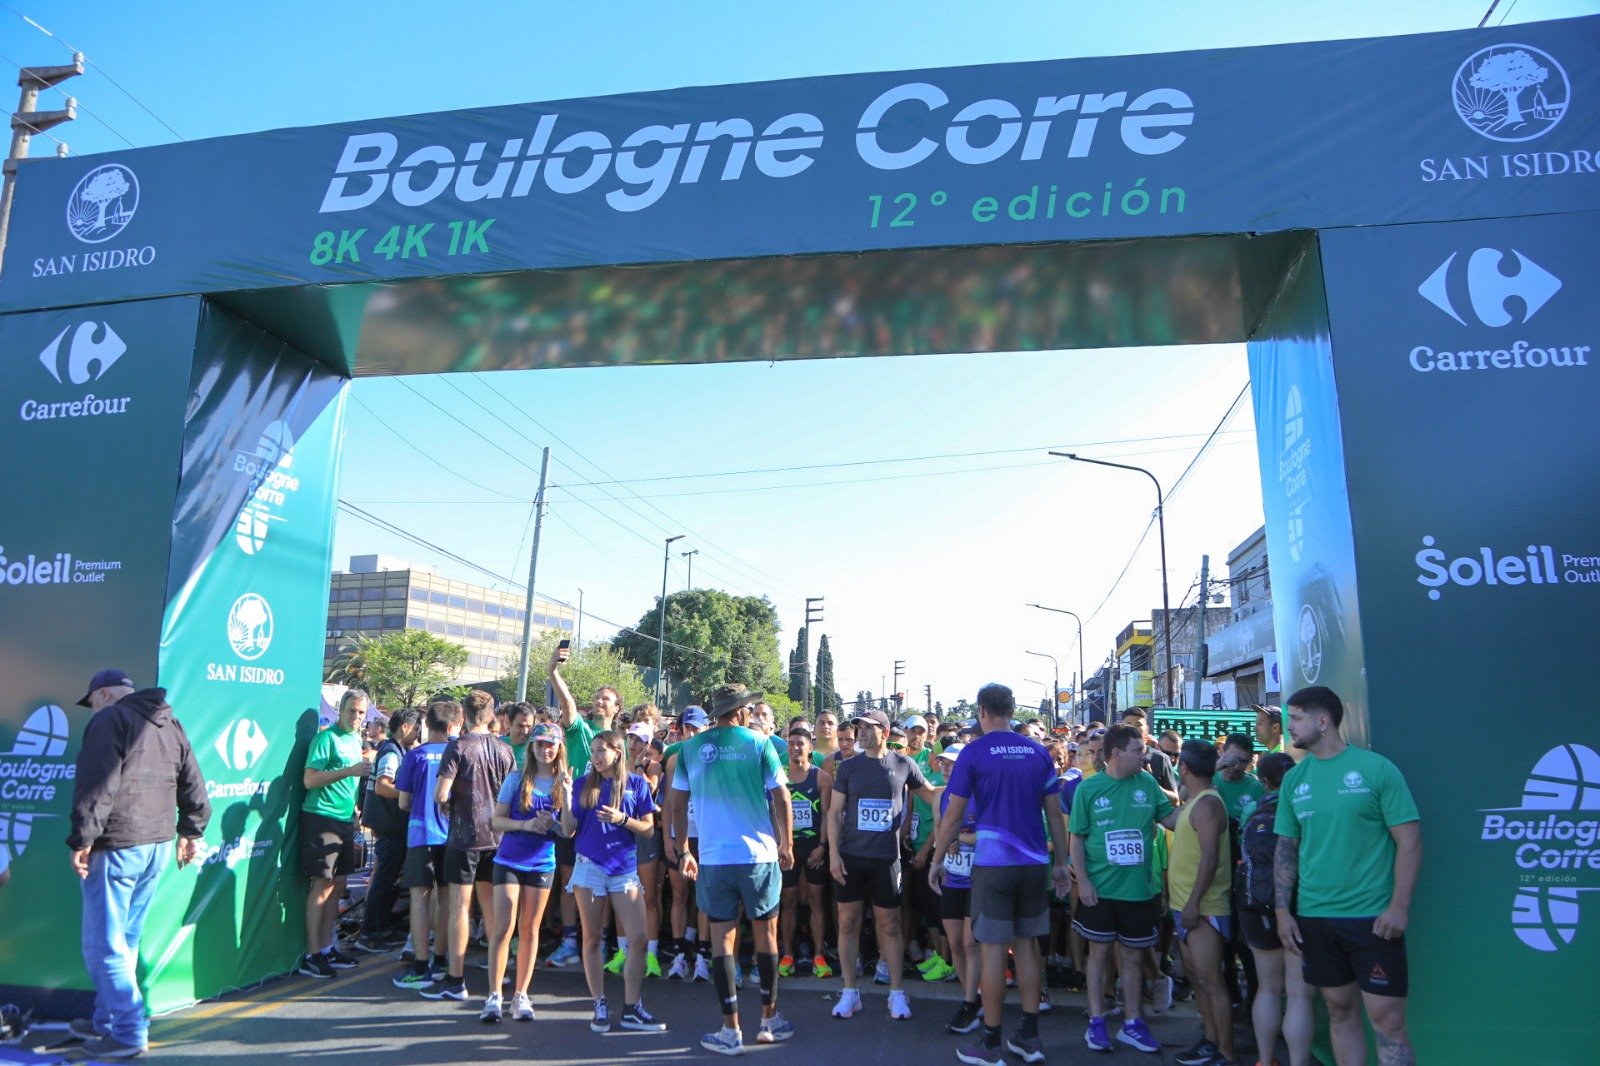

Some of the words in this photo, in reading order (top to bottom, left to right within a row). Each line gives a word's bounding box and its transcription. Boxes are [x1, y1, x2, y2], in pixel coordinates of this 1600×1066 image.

[319, 112, 824, 214] Boulogne
[855, 82, 1195, 170] Corre
[1420, 155, 1489, 182] SAN
[1501, 148, 1600, 177] ISIDR
[867, 190, 949, 229] 12°
[971, 176, 1187, 223] edición
[309, 228, 365, 267] 8K
[372, 223, 432, 261] 4K
[447, 217, 497, 256] 1K
[32, 254, 76, 278] SAN
[82, 245, 156, 272] ISIDRO
[1408, 340, 1591, 373] Carrefour
[20, 393, 131, 422] Carrefour
[232, 452, 300, 492] Boulogne
[73, 571, 106, 583] Outlet
[75, 559, 122, 571] Premium
[1415, 534, 1559, 601] Soleil
[207, 663, 236, 681] SAN
[239, 666, 285, 686] ISIDRO
[990, 746, 1007, 755] SAN
[1008, 746, 1035, 755] ISIDRO
[0, 759, 76, 783] oulogne
[1, 779, 56, 800] Corre
[205, 777, 271, 799] Carrefour
[861, 808, 890, 823] 902
[1481, 814, 1600, 847] Boulog
[947, 852, 971, 867] 901
[1109, 842, 1142, 856] 5368
[1515, 843, 1600, 869] Corre
[1538, 874, 1577, 882] edición
